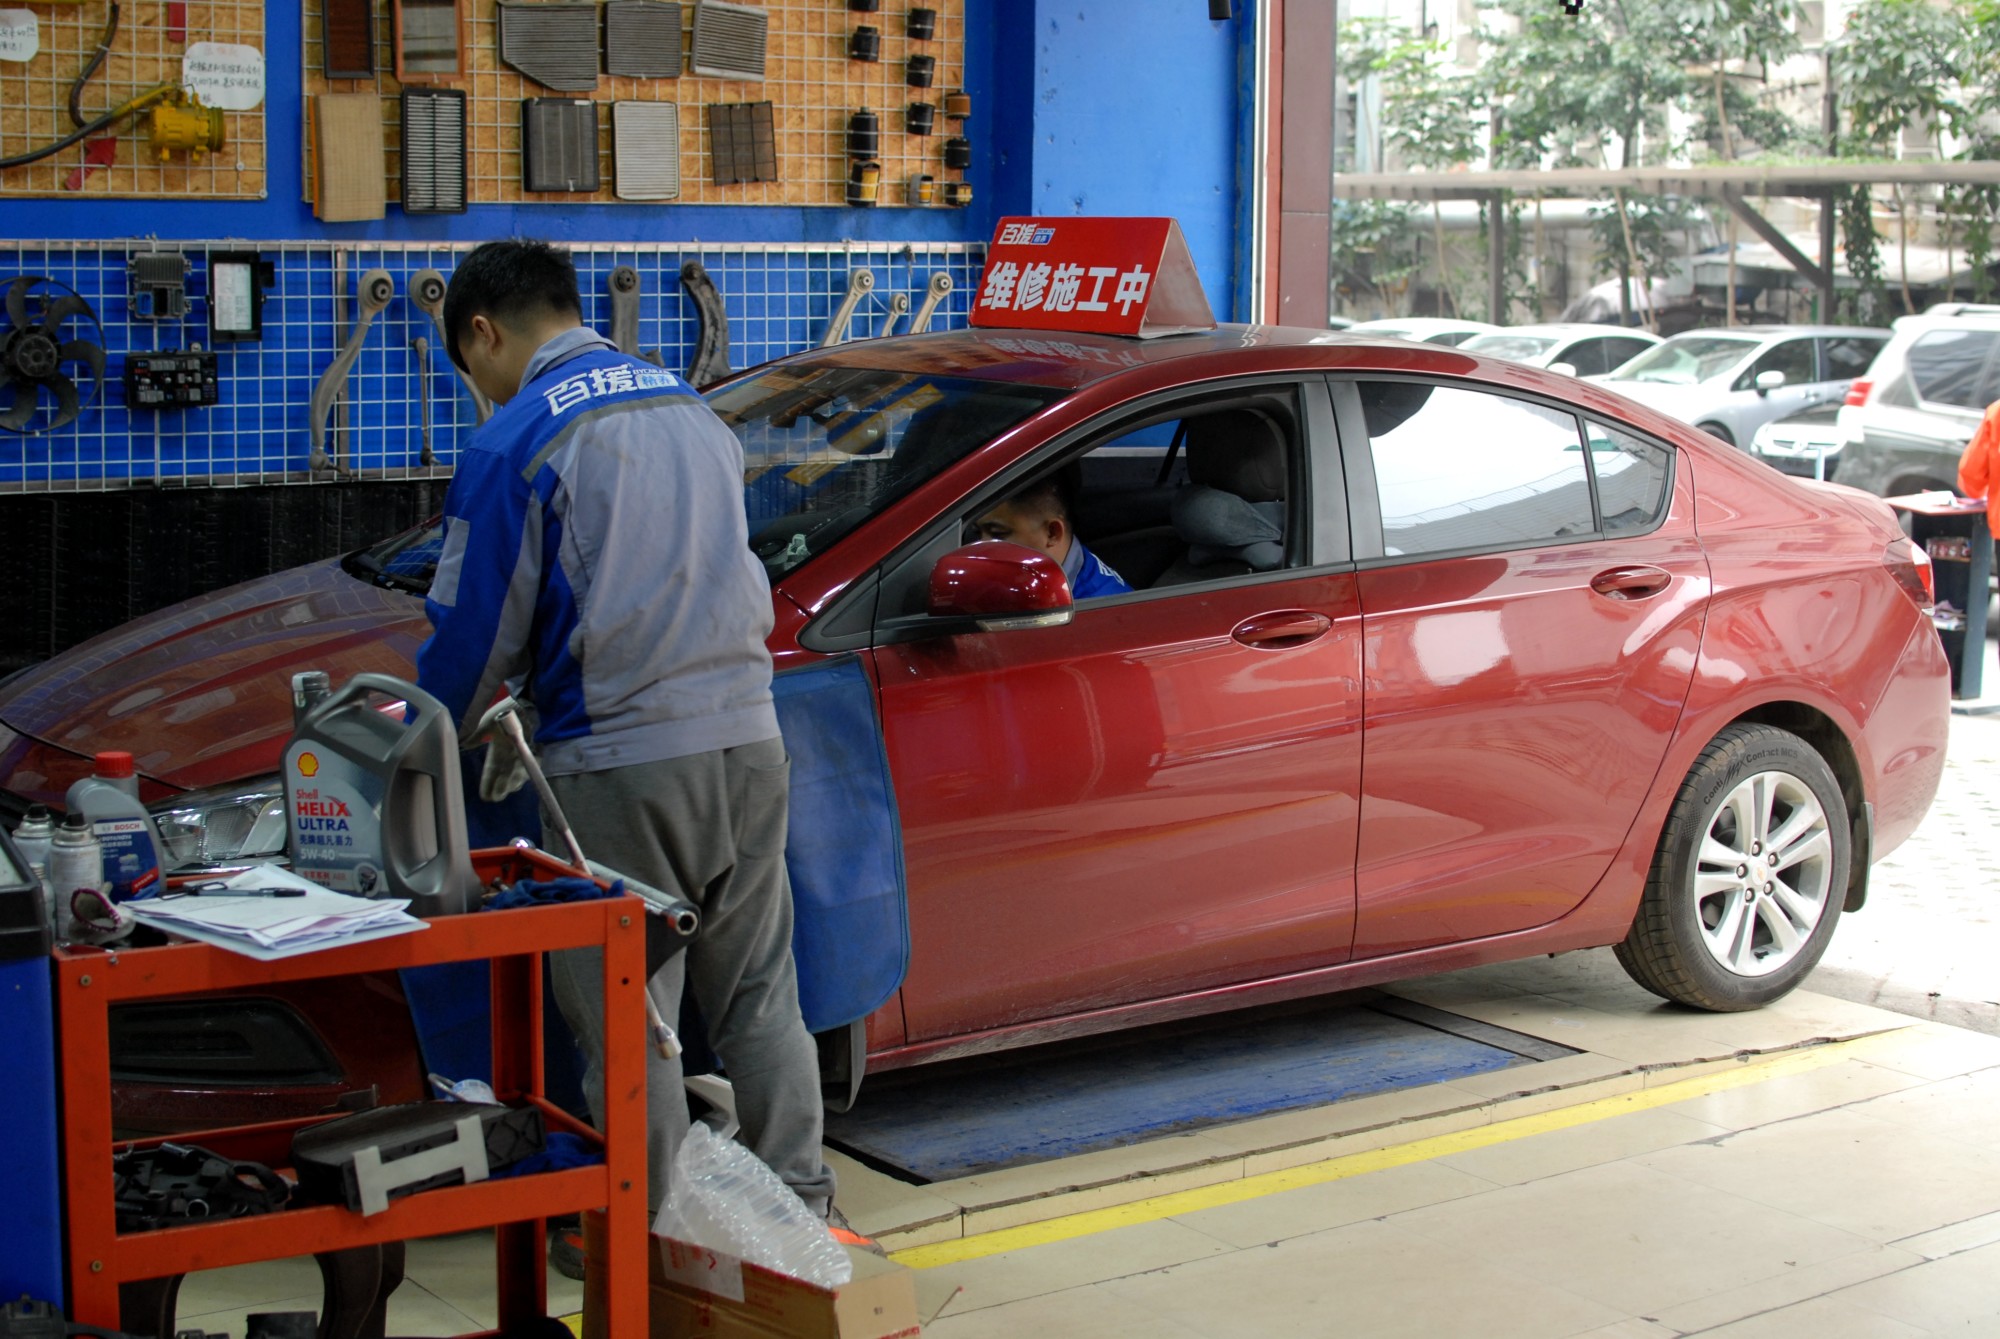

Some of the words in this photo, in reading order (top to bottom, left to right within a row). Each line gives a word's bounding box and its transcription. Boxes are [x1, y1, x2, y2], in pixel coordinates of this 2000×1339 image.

[998, 223, 1038, 245] 百援
[980, 261, 1150, 317] 维修施工中
[543, 363, 638, 417] 百援
[296, 788, 319, 800] Shell
[296, 802, 352, 817] HELIX
[114, 823, 140, 831] BOSCH
[298, 818, 350, 831] ULTRA
[300, 847, 336, 861] 5W-40
